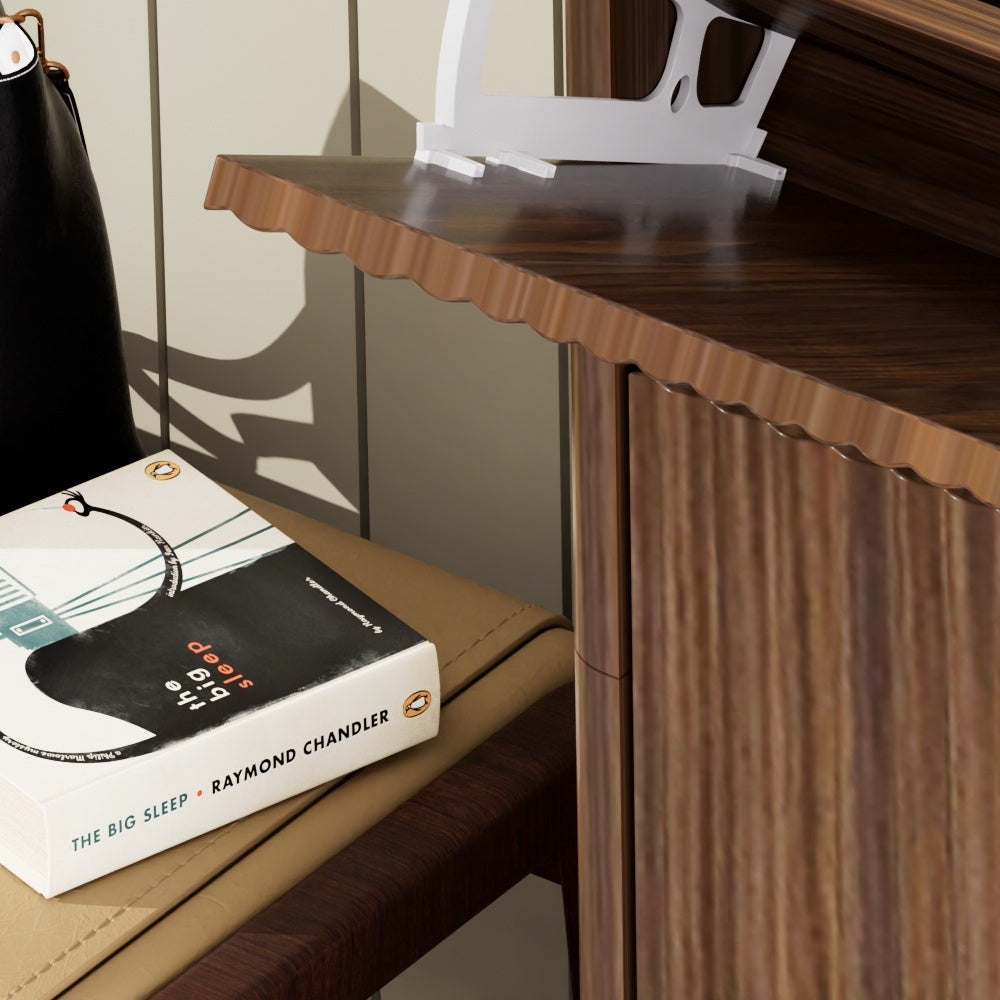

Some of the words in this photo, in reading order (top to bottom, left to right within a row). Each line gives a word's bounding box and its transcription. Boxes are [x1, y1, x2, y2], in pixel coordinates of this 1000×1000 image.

[305, 576, 338, 602] Chandler
[335, 601, 373, 628] Raymond
[187, 641, 254, 689] sleep
[164, 680, 207, 711] the
[186, 667, 231, 702] big
[71, 829, 101, 852] THE
[108, 815, 136, 837] BIG
[143, 793, 188, 823] SLEEP
[212, 748, 296, 794] RAYMOND
[303, 709, 389, 755] CHANDLER
